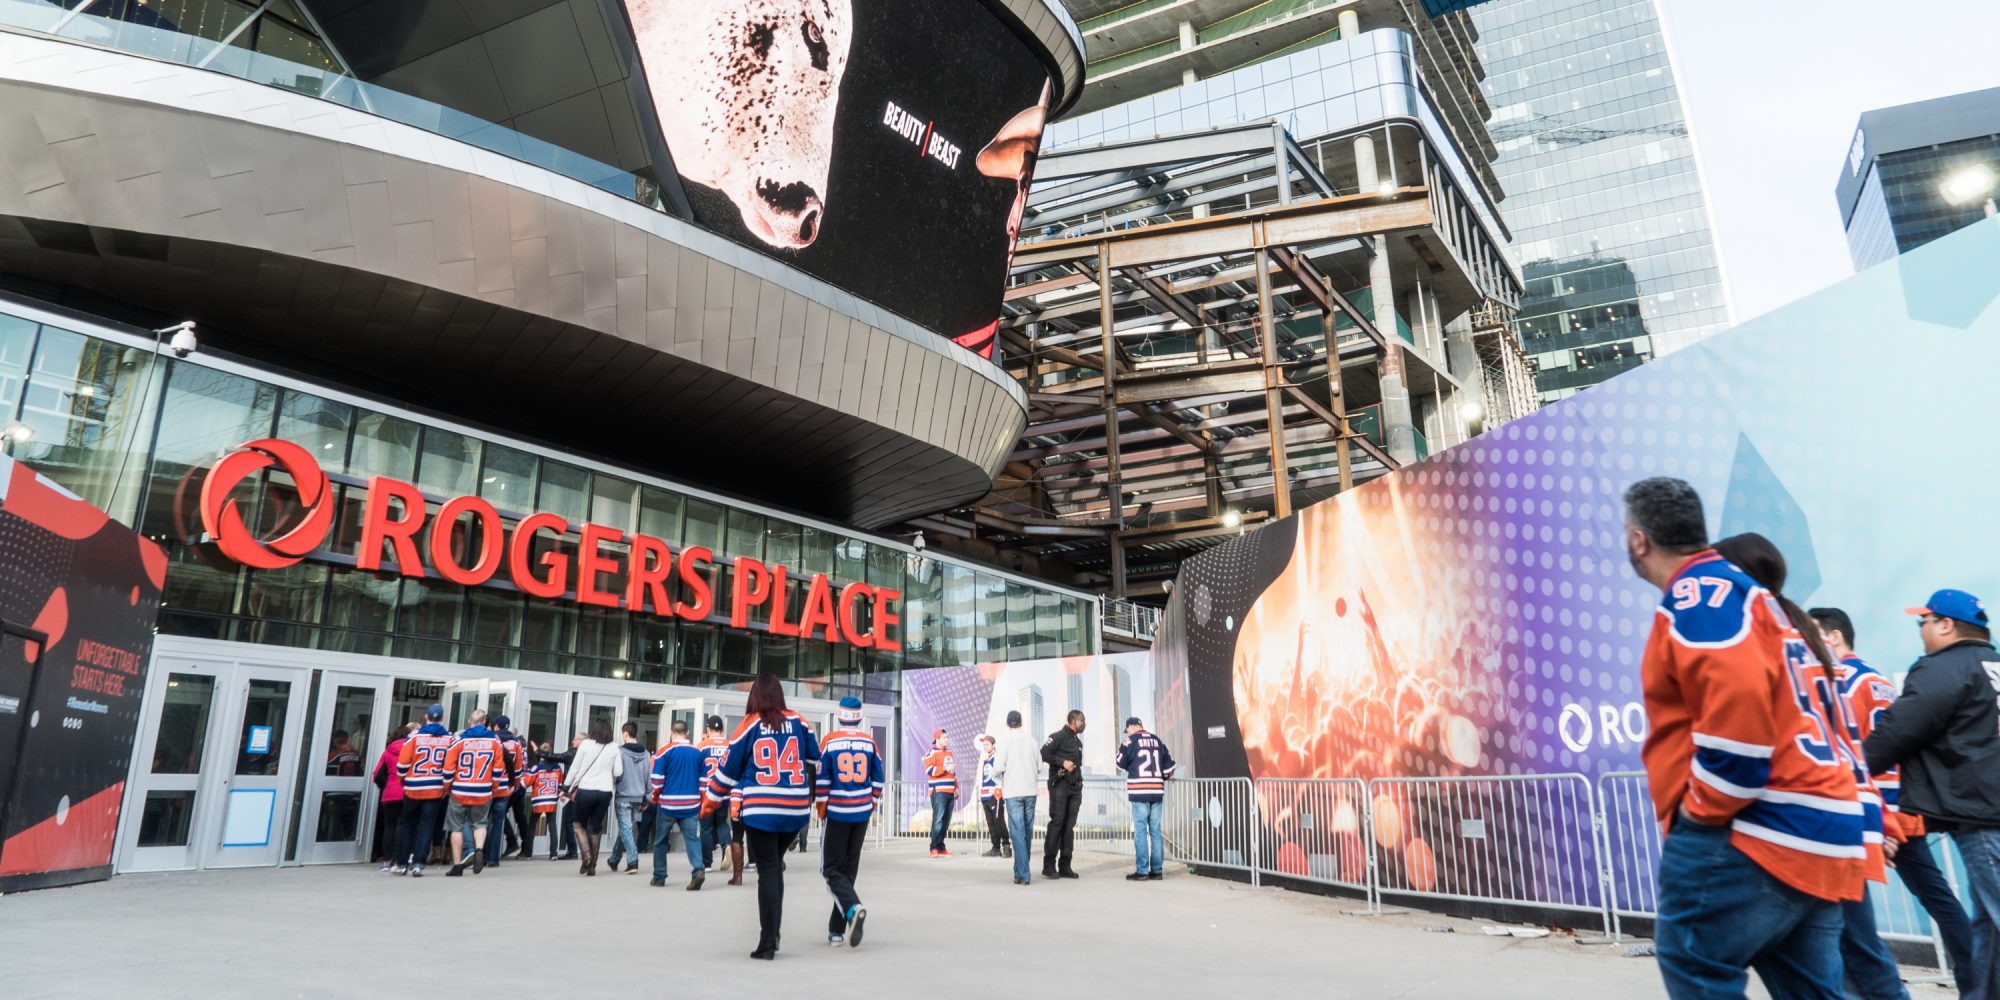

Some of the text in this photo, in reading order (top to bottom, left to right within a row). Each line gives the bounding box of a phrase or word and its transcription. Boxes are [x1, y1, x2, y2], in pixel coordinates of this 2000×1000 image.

[883, 101, 962, 170] BEAUTY BEAST
[356, 476, 901, 651] ROGERS PLACE
[1672, 576, 1733, 611] 97
[76, 638, 141, 675] UNFORGETTABLE
[71, 664, 104, 693] STARTS
[413, 745, 448, 776] 29
[458, 750, 495, 780] 97
[753, 736, 805, 785] 94
[837, 752, 868, 783] 93
[1138, 749, 1162, 777] 21
[539, 779, 558, 796] 29
